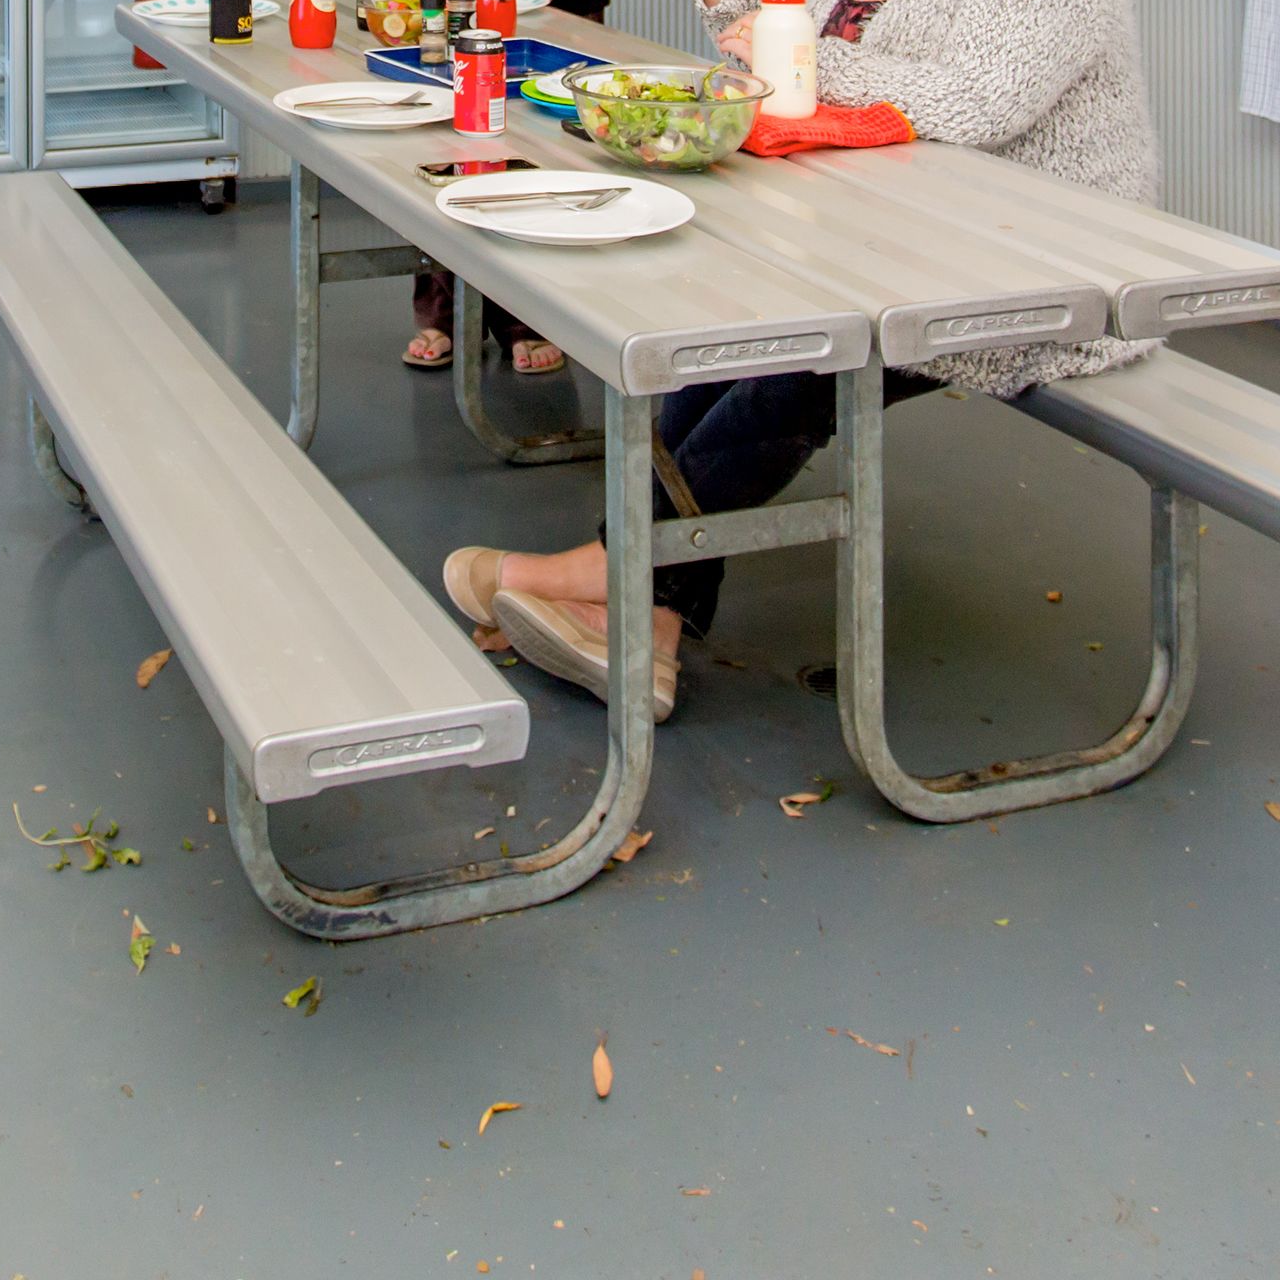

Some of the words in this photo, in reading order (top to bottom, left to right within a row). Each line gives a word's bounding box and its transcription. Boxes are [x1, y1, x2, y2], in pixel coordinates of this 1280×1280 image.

[1181, 288, 1270, 315] CAPRAL
[947, 312, 1044, 337] CAPRAL
[697, 337, 801, 366] CAPRAL
[335, 732, 452, 766] CAPRAL
